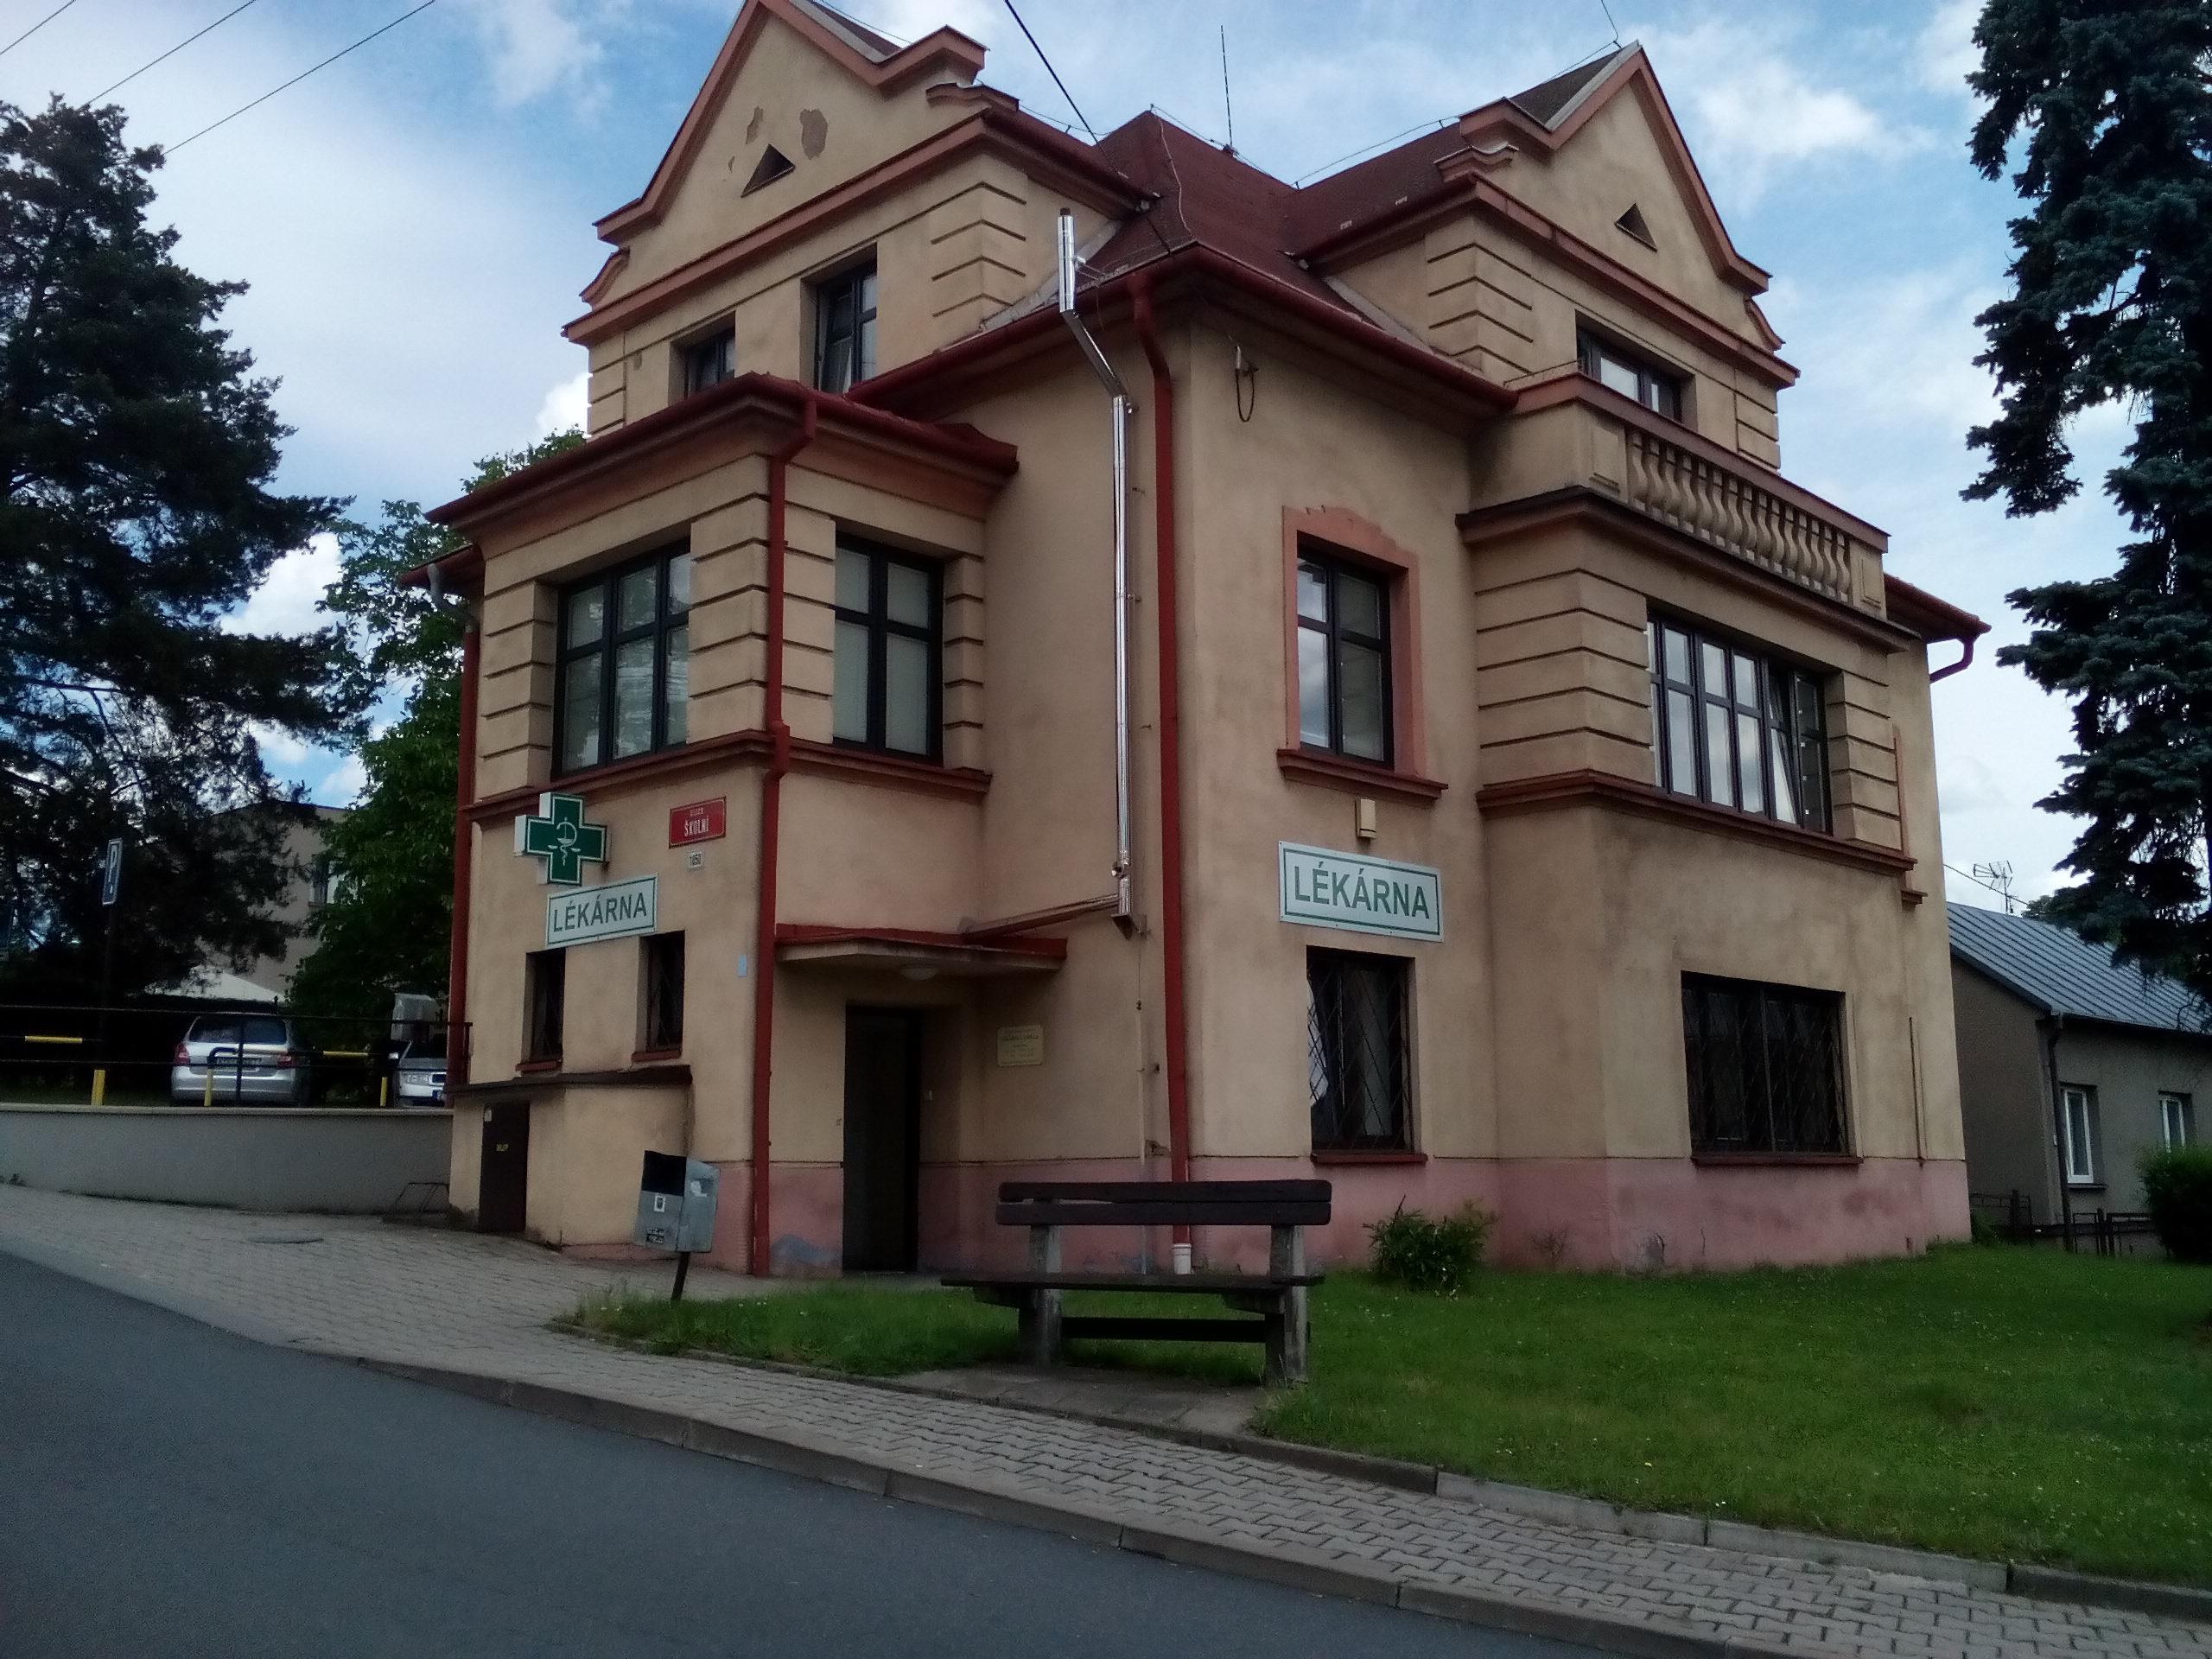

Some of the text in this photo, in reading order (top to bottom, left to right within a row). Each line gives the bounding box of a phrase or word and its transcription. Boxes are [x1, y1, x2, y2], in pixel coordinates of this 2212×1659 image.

[684, 815, 709, 837] ŠKOLNÍ
[1294, 861, 1430, 919] LÉKÁRNA
[553, 892, 647, 933] LÉKÁRNA
